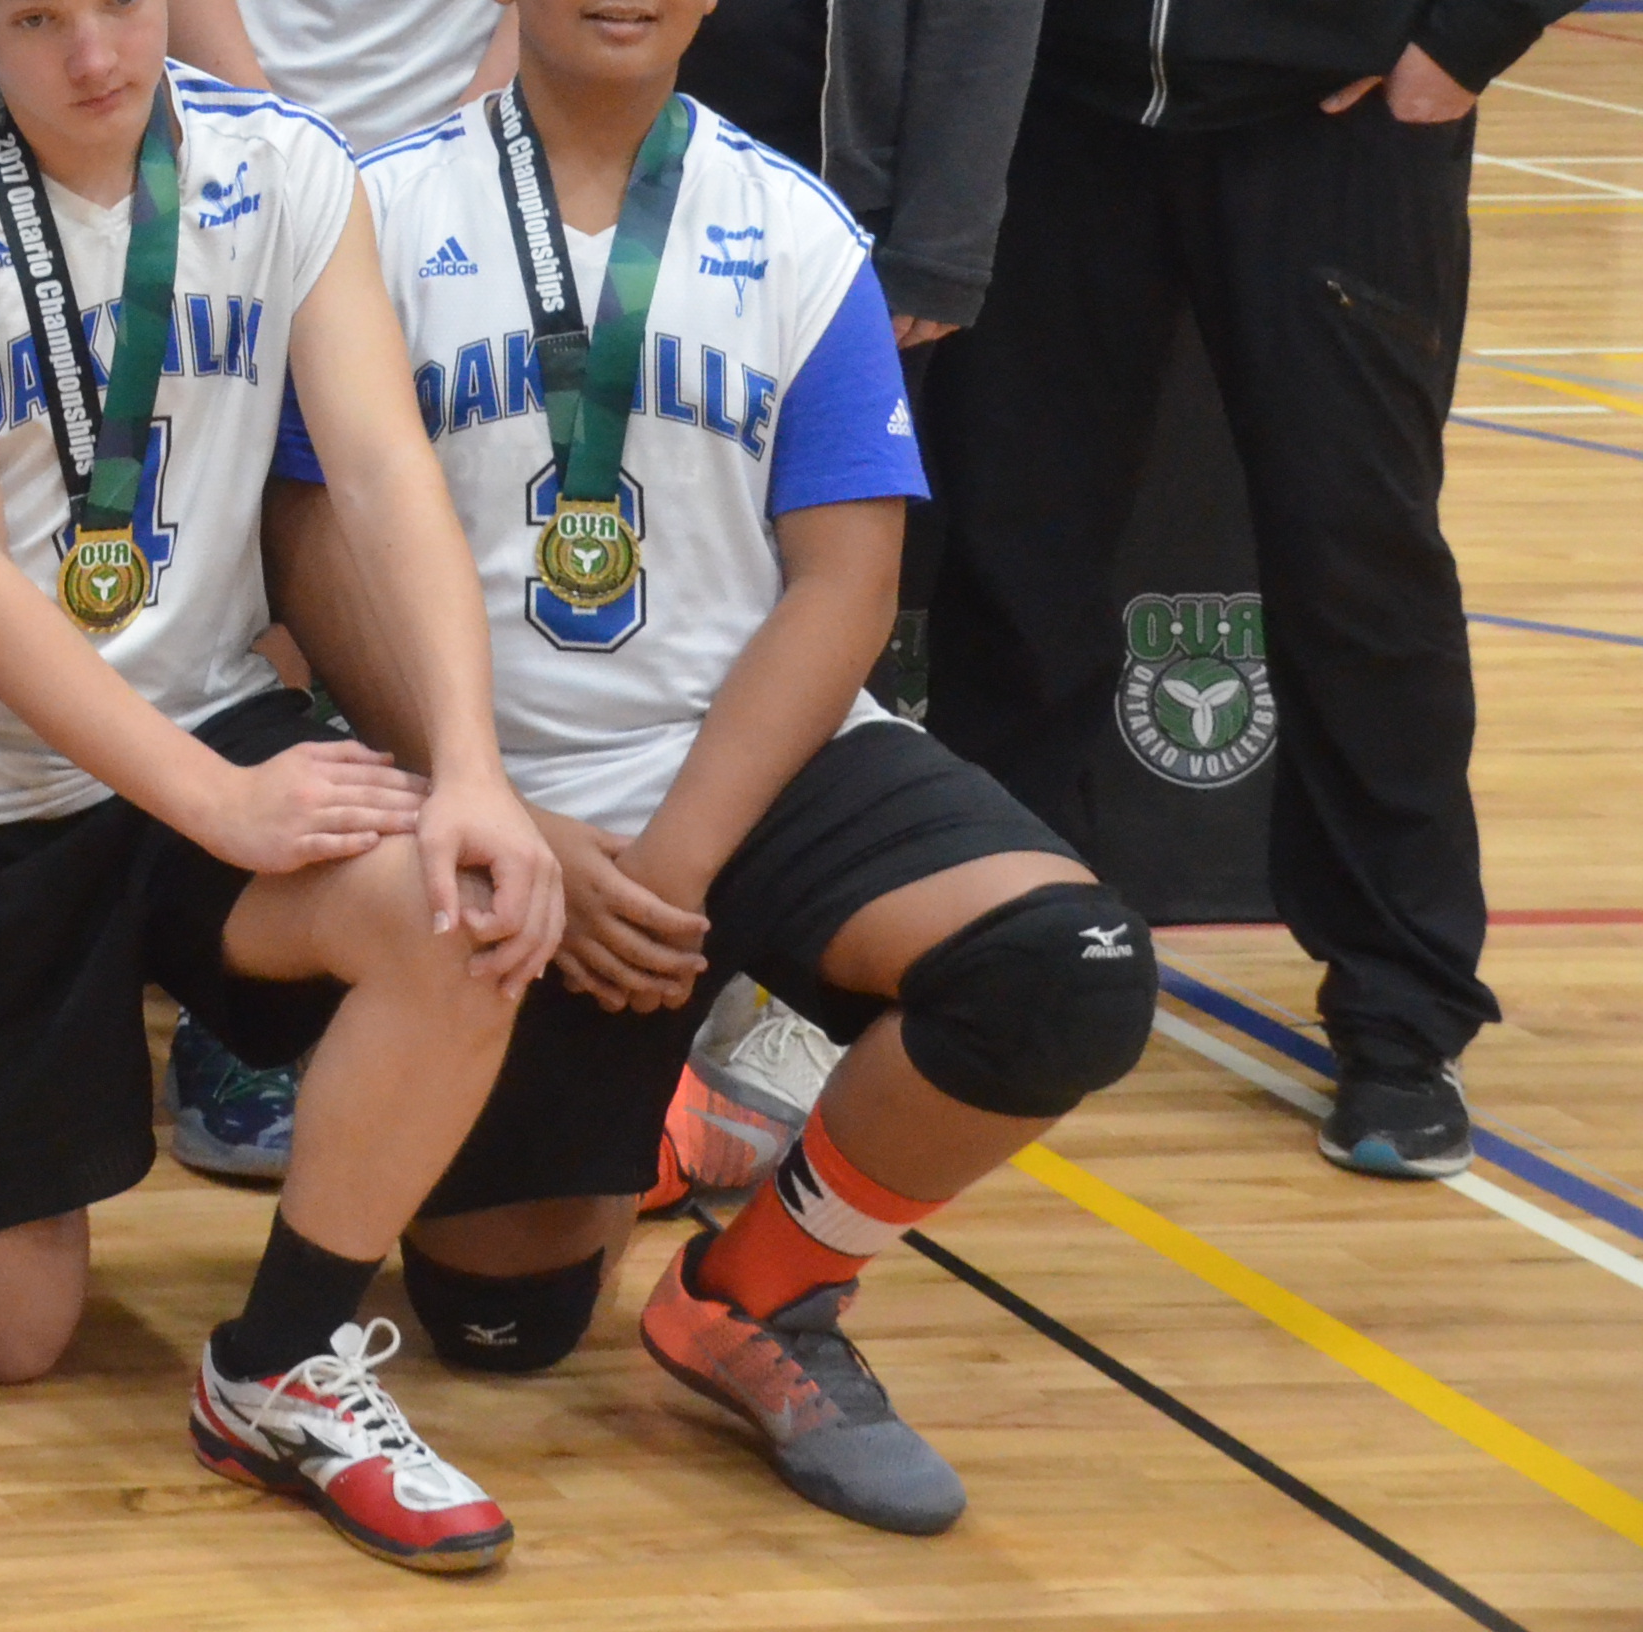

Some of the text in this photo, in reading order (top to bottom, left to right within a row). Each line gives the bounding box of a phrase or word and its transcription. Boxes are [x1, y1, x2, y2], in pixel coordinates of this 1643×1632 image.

[418, 260, 478, 278] adidas
[507, 130, 565, 315] Championships
[8, 181, 55, 280] Ontario
[34, 276, 98, 477] Championships
[414, 327, 781, 462] OAKLLE
[1126, 665, 1175, 773] ONTARIO
